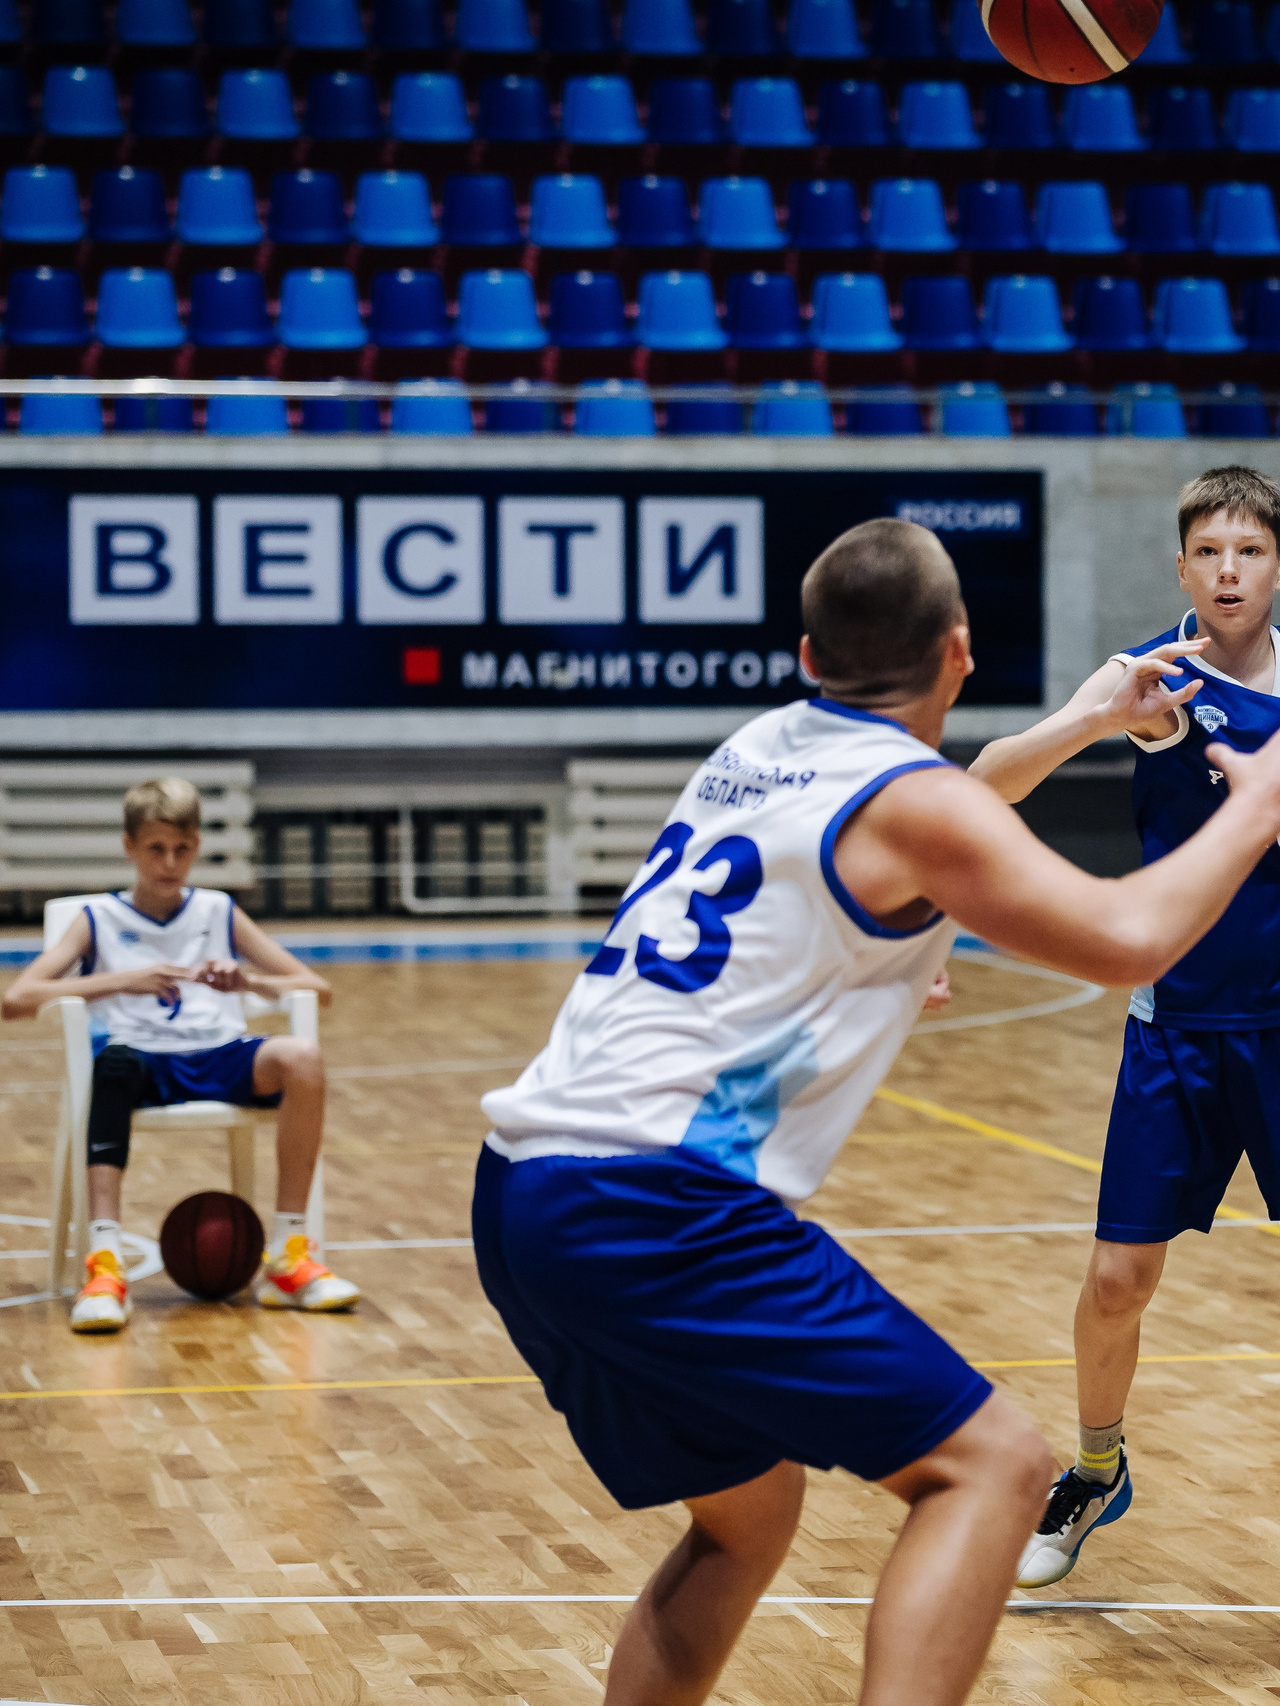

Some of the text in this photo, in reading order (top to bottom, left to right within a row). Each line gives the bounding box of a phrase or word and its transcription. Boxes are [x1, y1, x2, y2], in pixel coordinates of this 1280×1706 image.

[97, 523, 735, 597] ВЕСТИ
[462, 651, 821, 688] МАГНИТОГОР
[585, 821, 763, 993] 23
